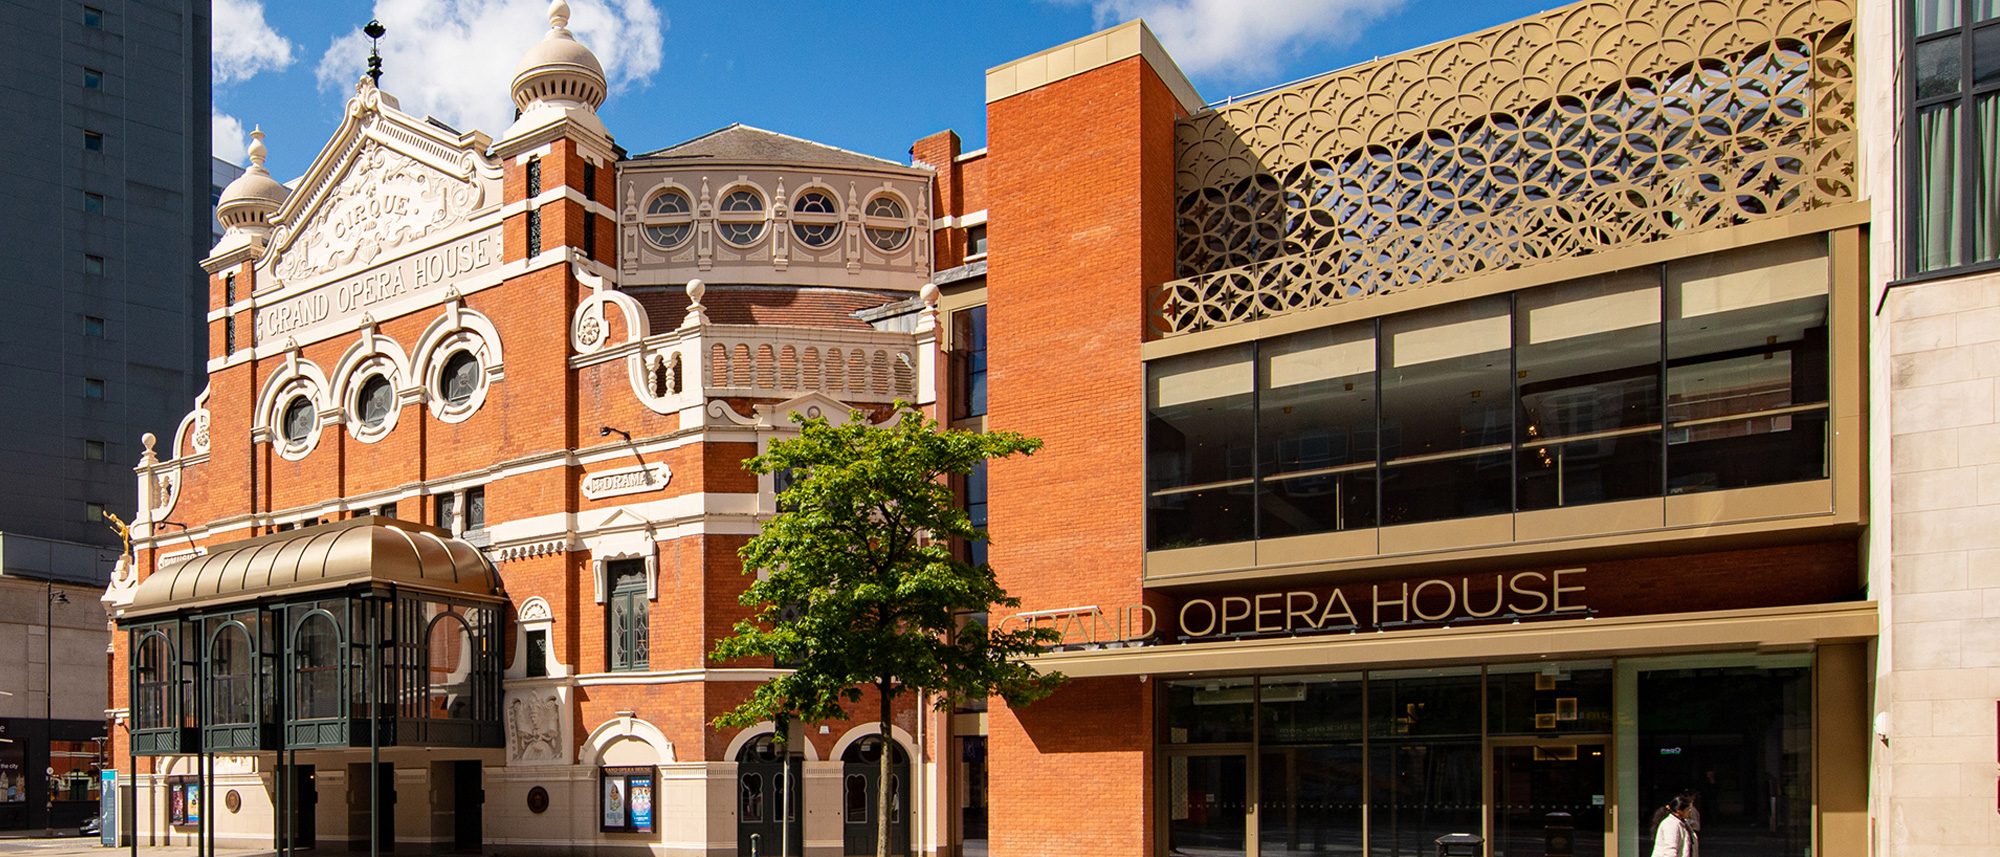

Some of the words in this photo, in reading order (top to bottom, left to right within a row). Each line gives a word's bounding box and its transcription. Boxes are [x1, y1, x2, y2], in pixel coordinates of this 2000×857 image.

[335, 195, 410, 238] CIRQUE
[268, 292, 329, 336] GRAND
[337, 265, 406, 313] OPERA
[414, 235, 492, 289] HOUSE
[1179, 588, 1359, 637] OPERA
[1373, 567, 1587, 623] HOUSE
